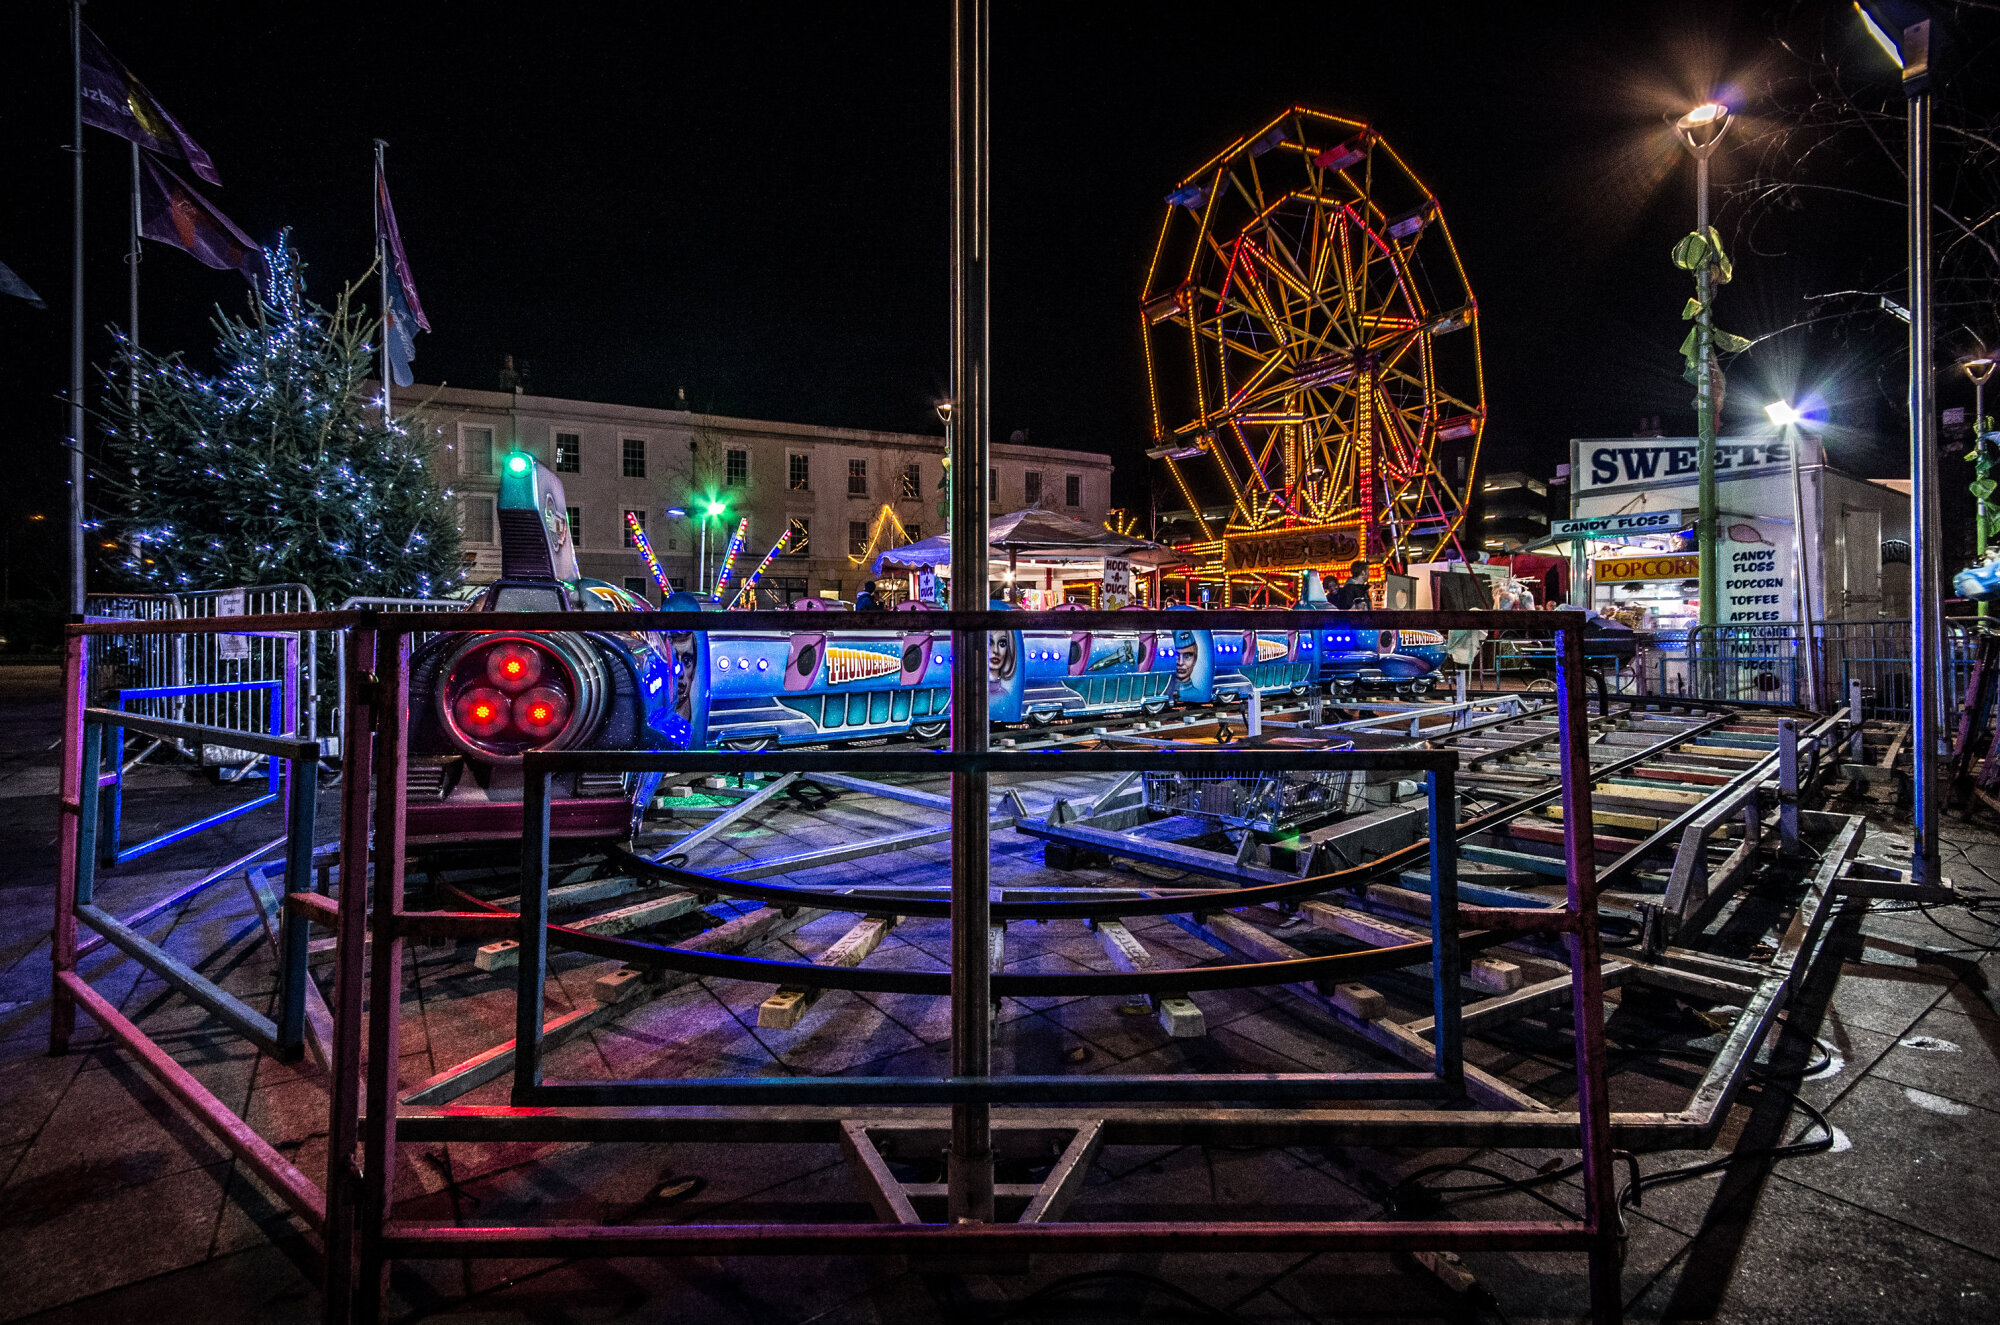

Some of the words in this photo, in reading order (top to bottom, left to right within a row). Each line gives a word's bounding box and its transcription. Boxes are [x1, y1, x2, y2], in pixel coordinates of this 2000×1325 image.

[1591, 444, 1790, 485] SWEETS
[1561, 519, 1612, 533] CANDY
[1618, 515, 1670, 528] FLOSS
[1732, 550, 1776, 561] CANDY
[1106, 560, 1129, 572] HOOK
[1601, 559, 1700, 578] POPCORN
[1733, 561, 1775, 573] FLOSS
[1105, 583, 1128, 595] DUCK
[1726, 578, 1784, 589] POPCORN
[1730, 594, 1779, 606] TOFFEE
[1730, 611, 1779, 621] APPLES
